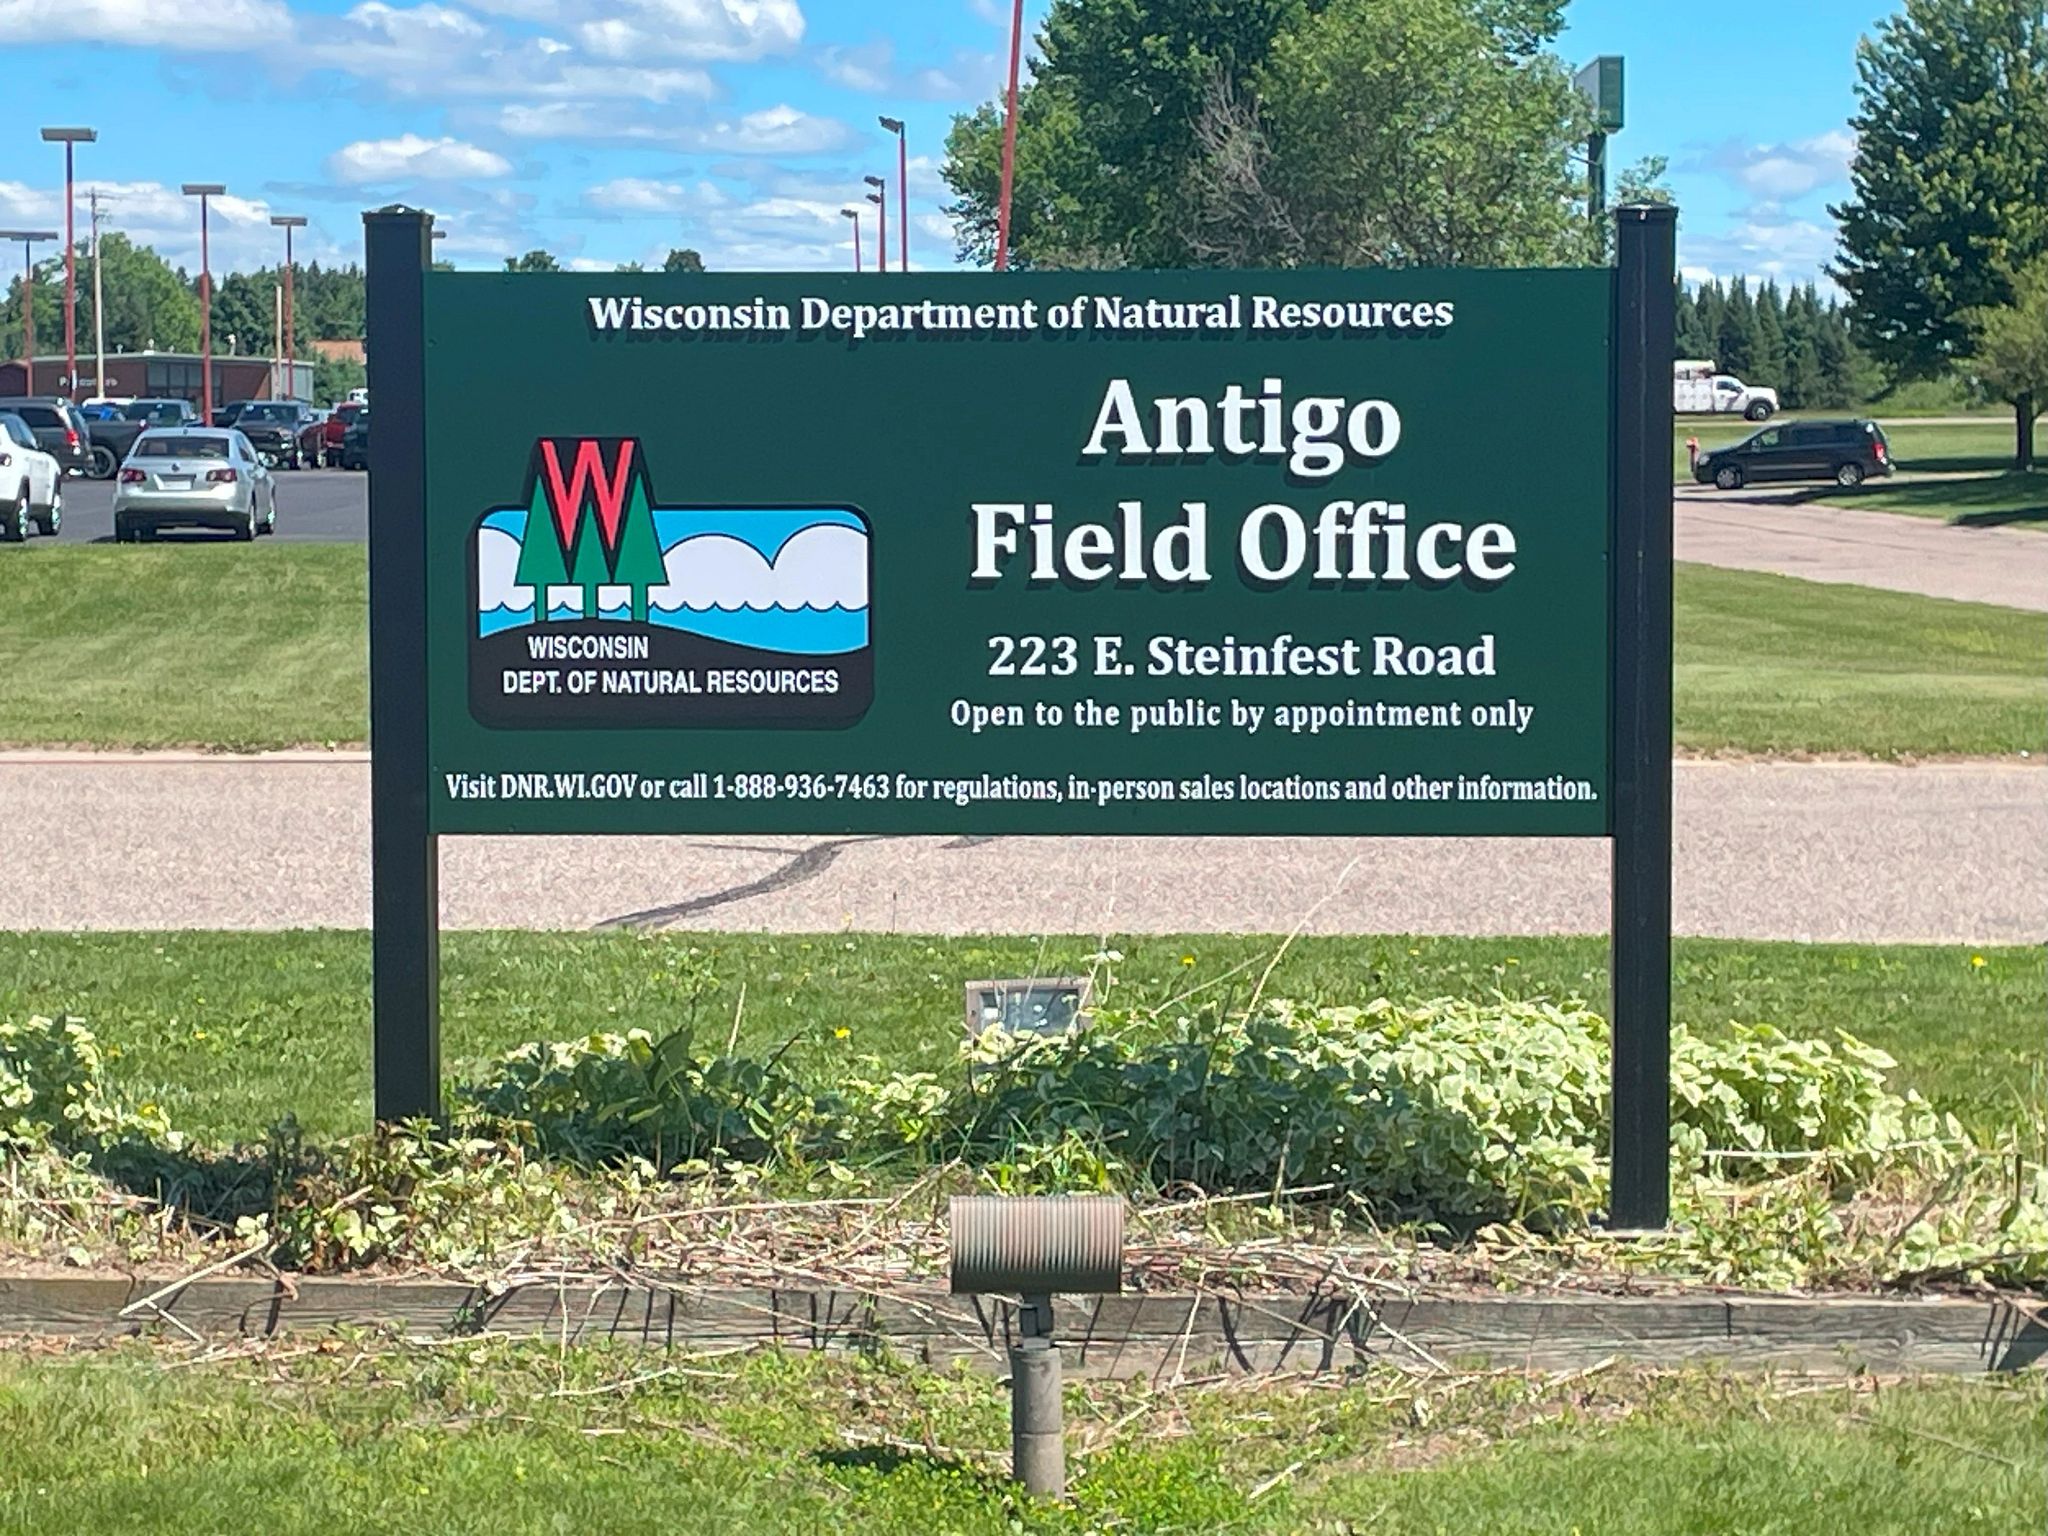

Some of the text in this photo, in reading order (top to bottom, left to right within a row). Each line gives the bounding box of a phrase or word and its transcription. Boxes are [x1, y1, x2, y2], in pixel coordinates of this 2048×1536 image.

[589, 295, 1453, 337] Wisconsin Department of Natural Resources
[1082, 378, 1400, 476] Antigo
[539, 440, 635, 552] W
[972, 501, 1516, 581] Field Office
[528, 636, 648, 659] WISCONSIN
[989, 635, 1495, 675] 223 E. Steinfest Road
[504, 670, 838, 694] DEPT. OF NATURAL RESOURCES
[952, 699, 1533, 733] Open to the public by appointment only
[446, 774, 1597, 806] Visit DNR.WI.GOV or call 1-888-936-7463 for regulations, in-person sales locations and other information.
